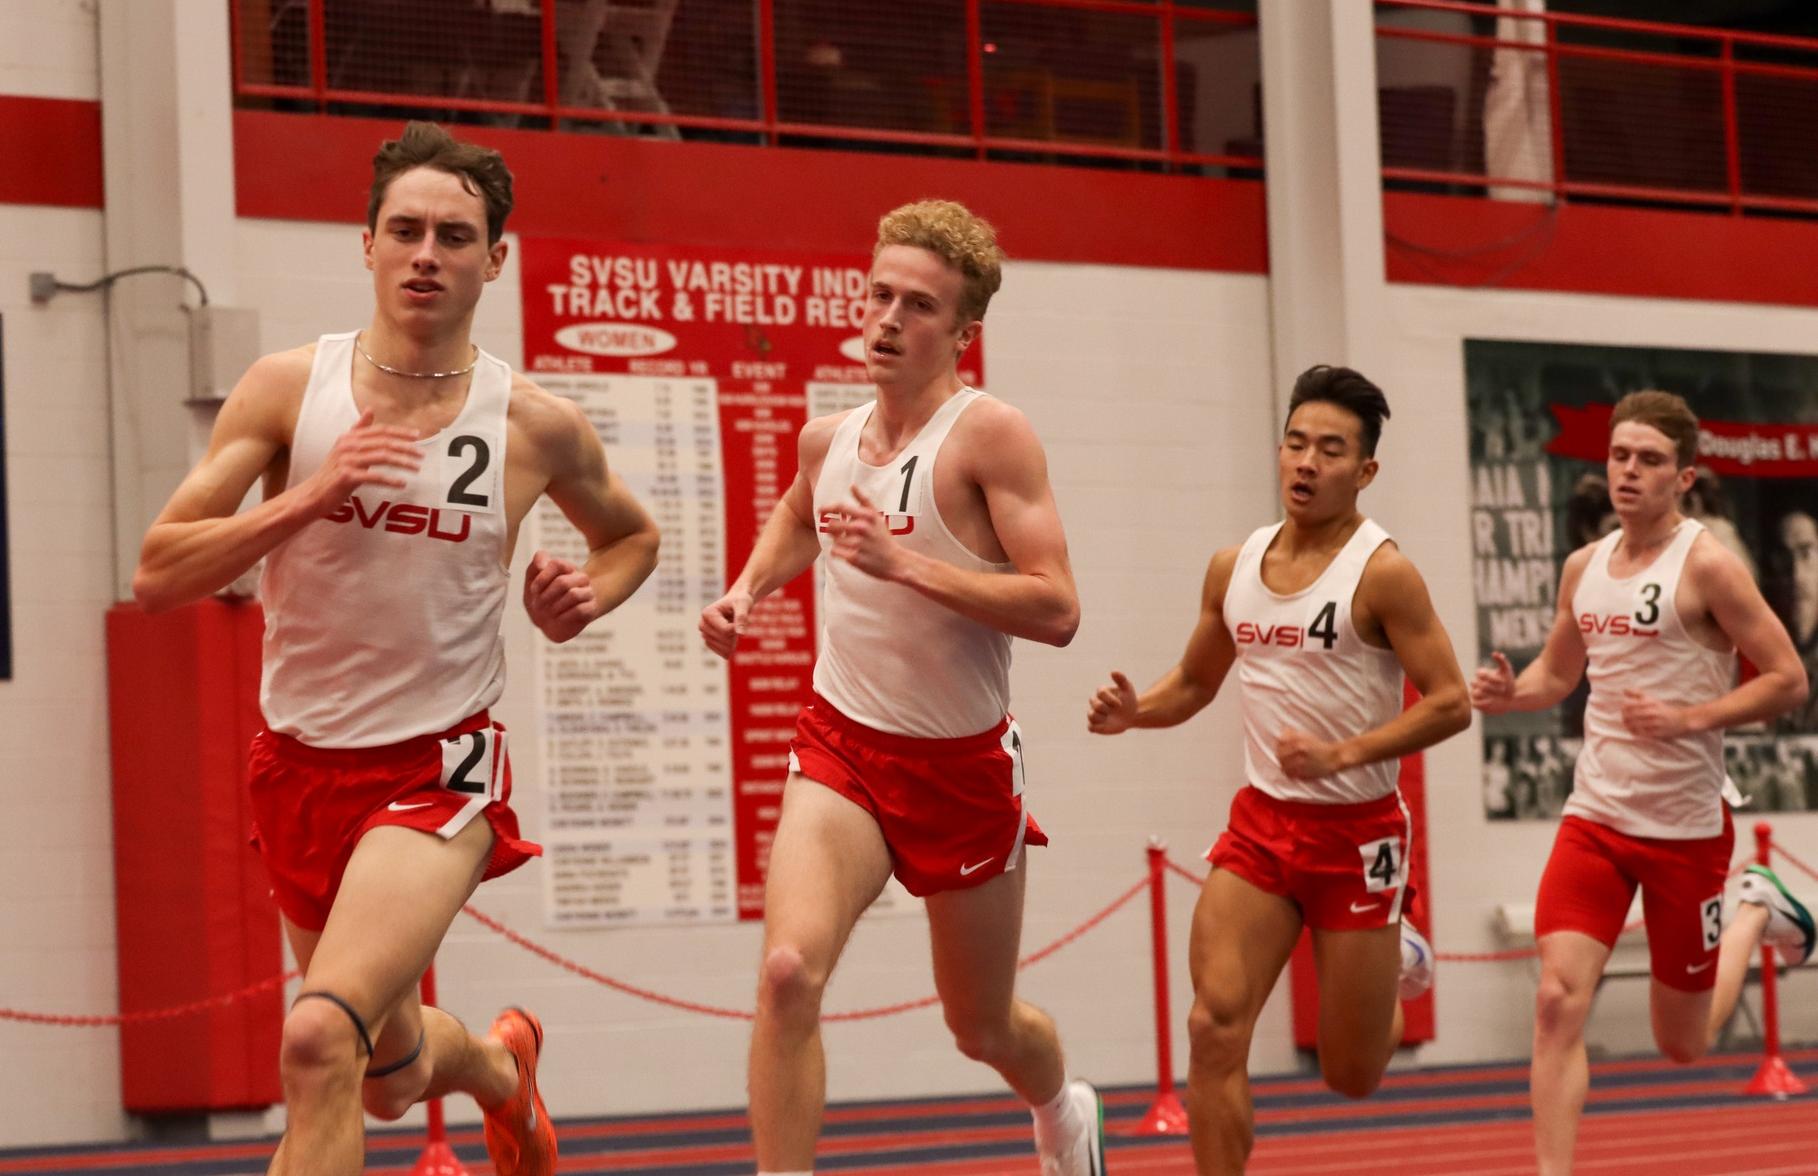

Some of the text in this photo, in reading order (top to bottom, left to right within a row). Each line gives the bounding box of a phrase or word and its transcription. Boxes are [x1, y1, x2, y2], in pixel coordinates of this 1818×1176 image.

[570, 254, 658, 289] SVSU
[667, 260, 803, 295] VARSITY
[546, 283, 662, 320] TRACK
[672, 290, 695, 321] &
[705, 292, 796, 326] FIELD
[576, 330, 657, 347] WOMEN
[532, 354, 593, 373] ATHLETE
[731, 361, 787, 380] EVENT
[446, 435, 491, 507] 2
[899, 455, 919, 513] 1
[1308, 601, 1338, 649] 4
[1635, 582, 1662, 625] 3
[447, 731, 486, 794] 2
[1369, 842, 1396, 886] 4
[1706, 900, 1721, 943] 3
